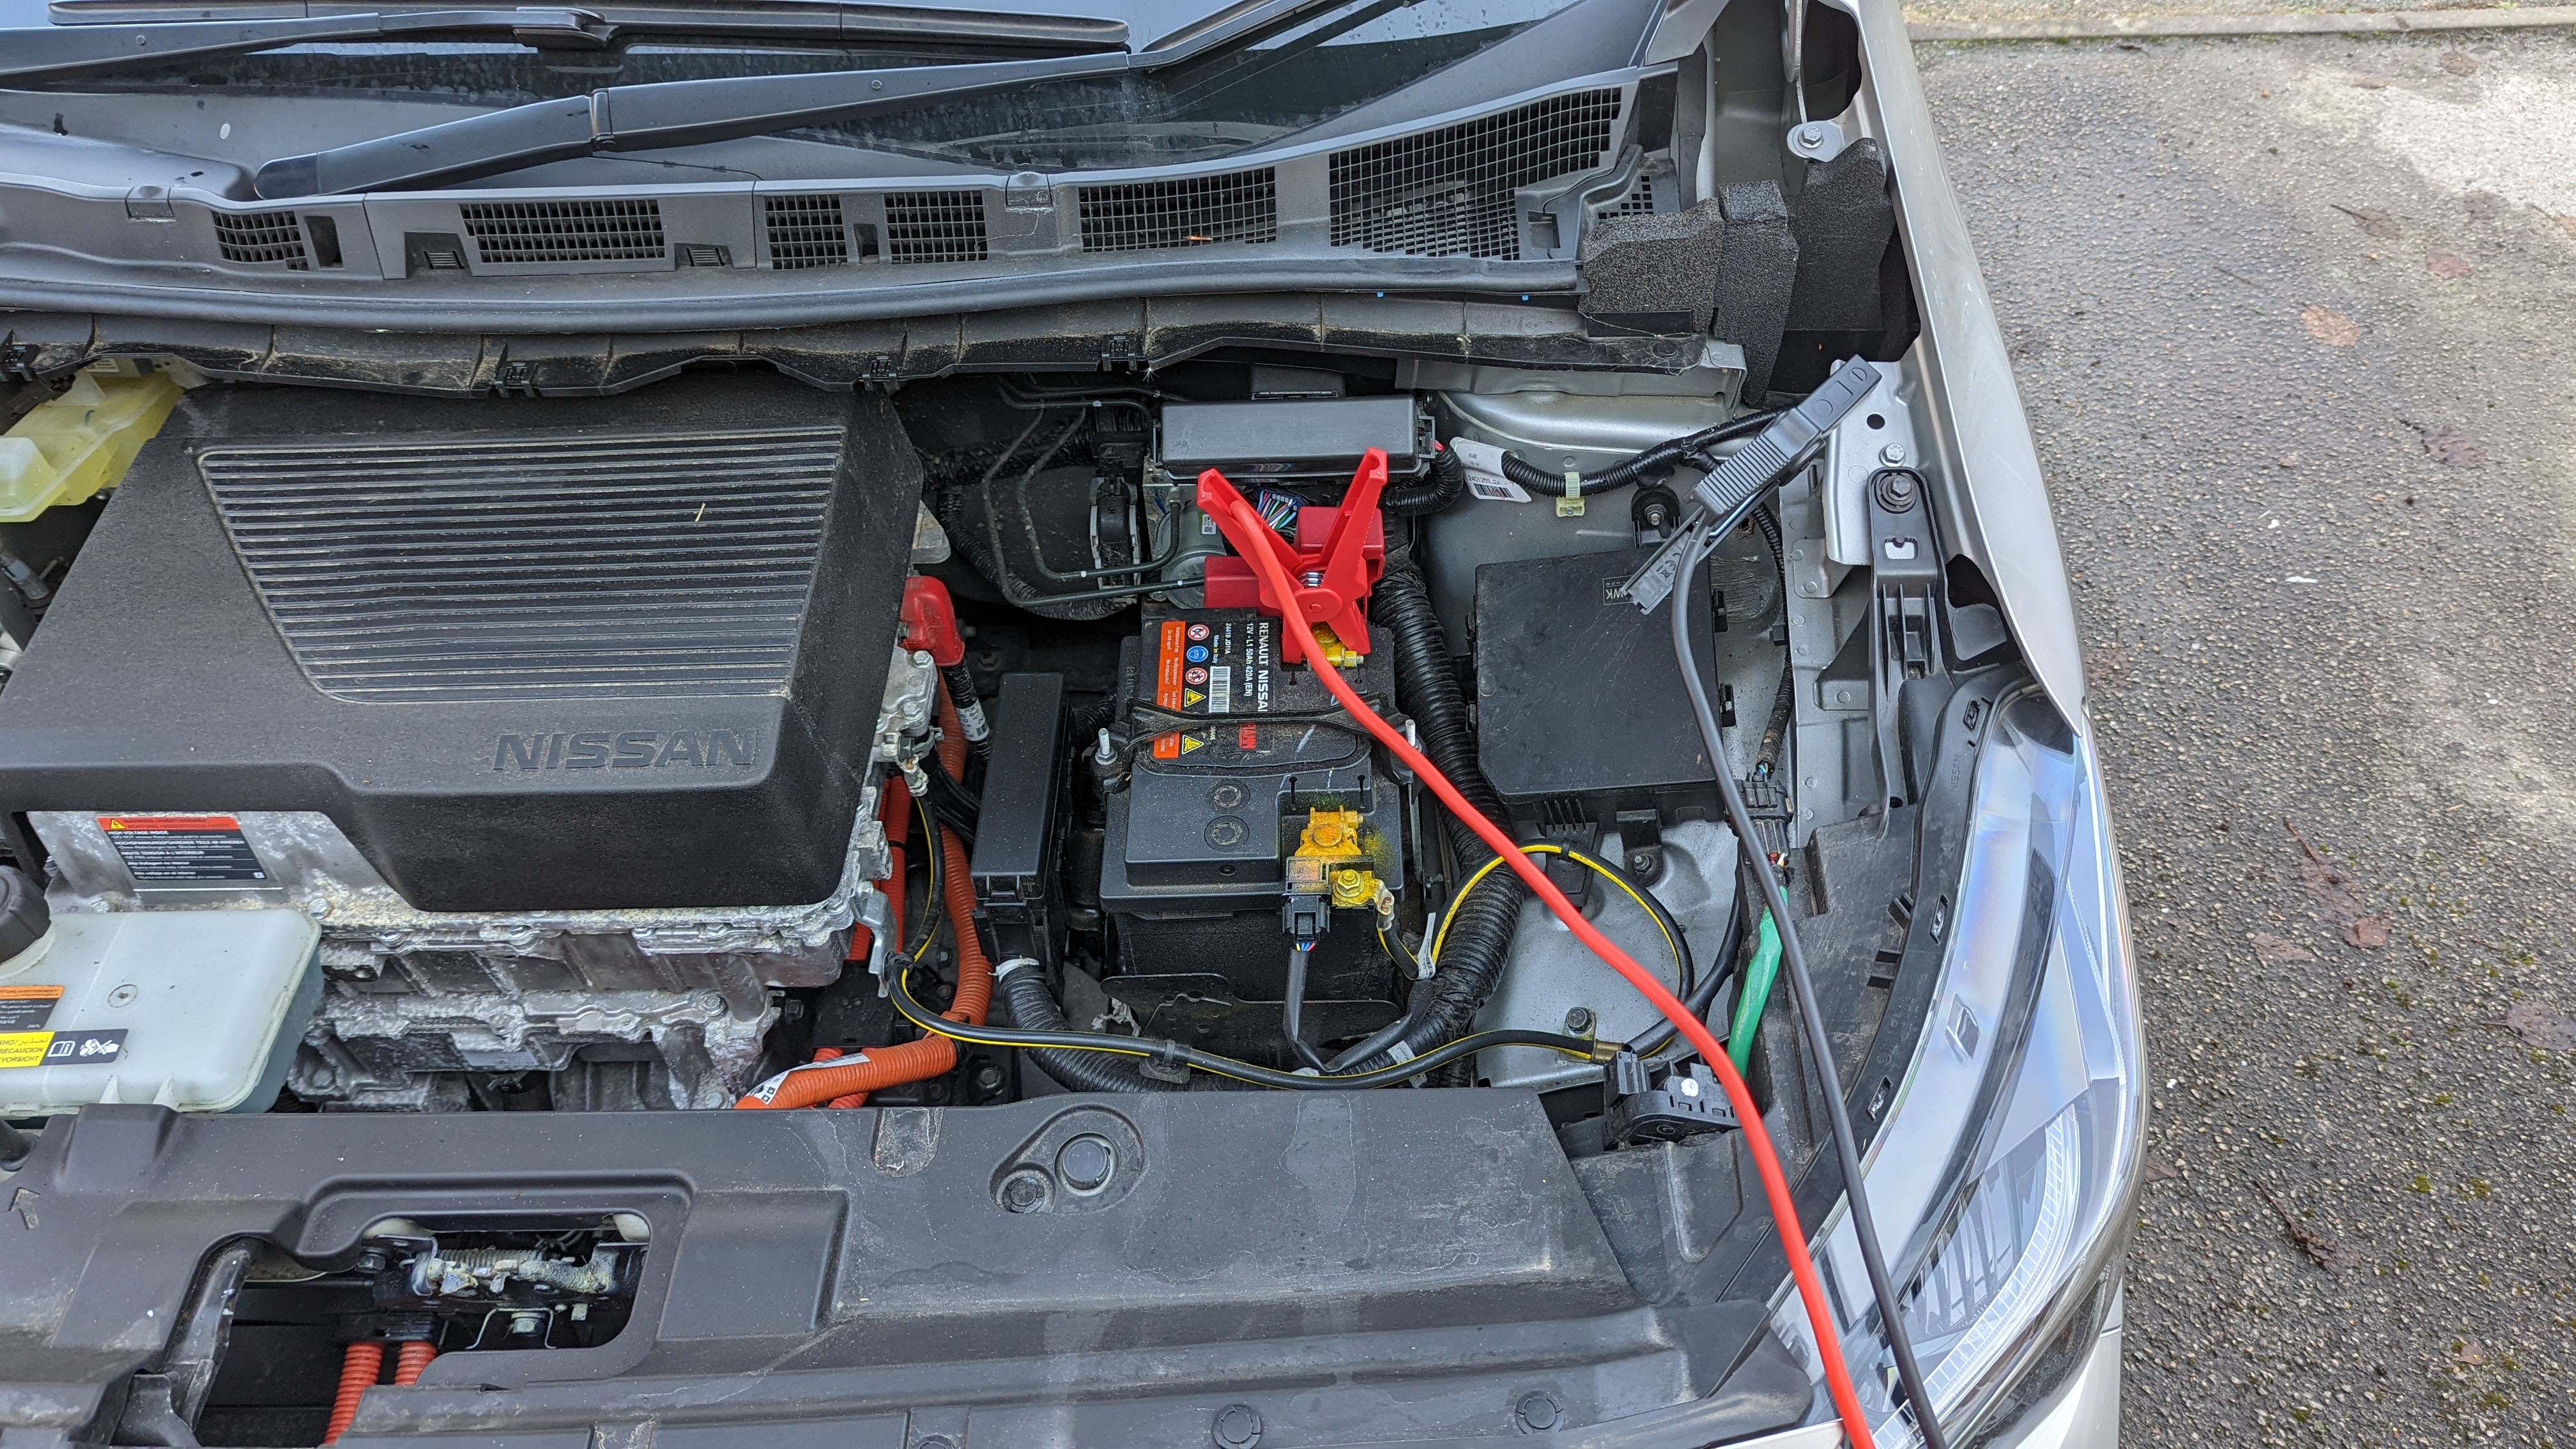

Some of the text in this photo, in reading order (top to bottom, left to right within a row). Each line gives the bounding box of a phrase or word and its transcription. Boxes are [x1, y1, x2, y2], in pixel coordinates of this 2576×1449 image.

[1257, 622, 1269, 712] RENAULT NISSA
[1243, 682, 1253, 696] (EN)
[493, 728, 758, 771] NISSAN
